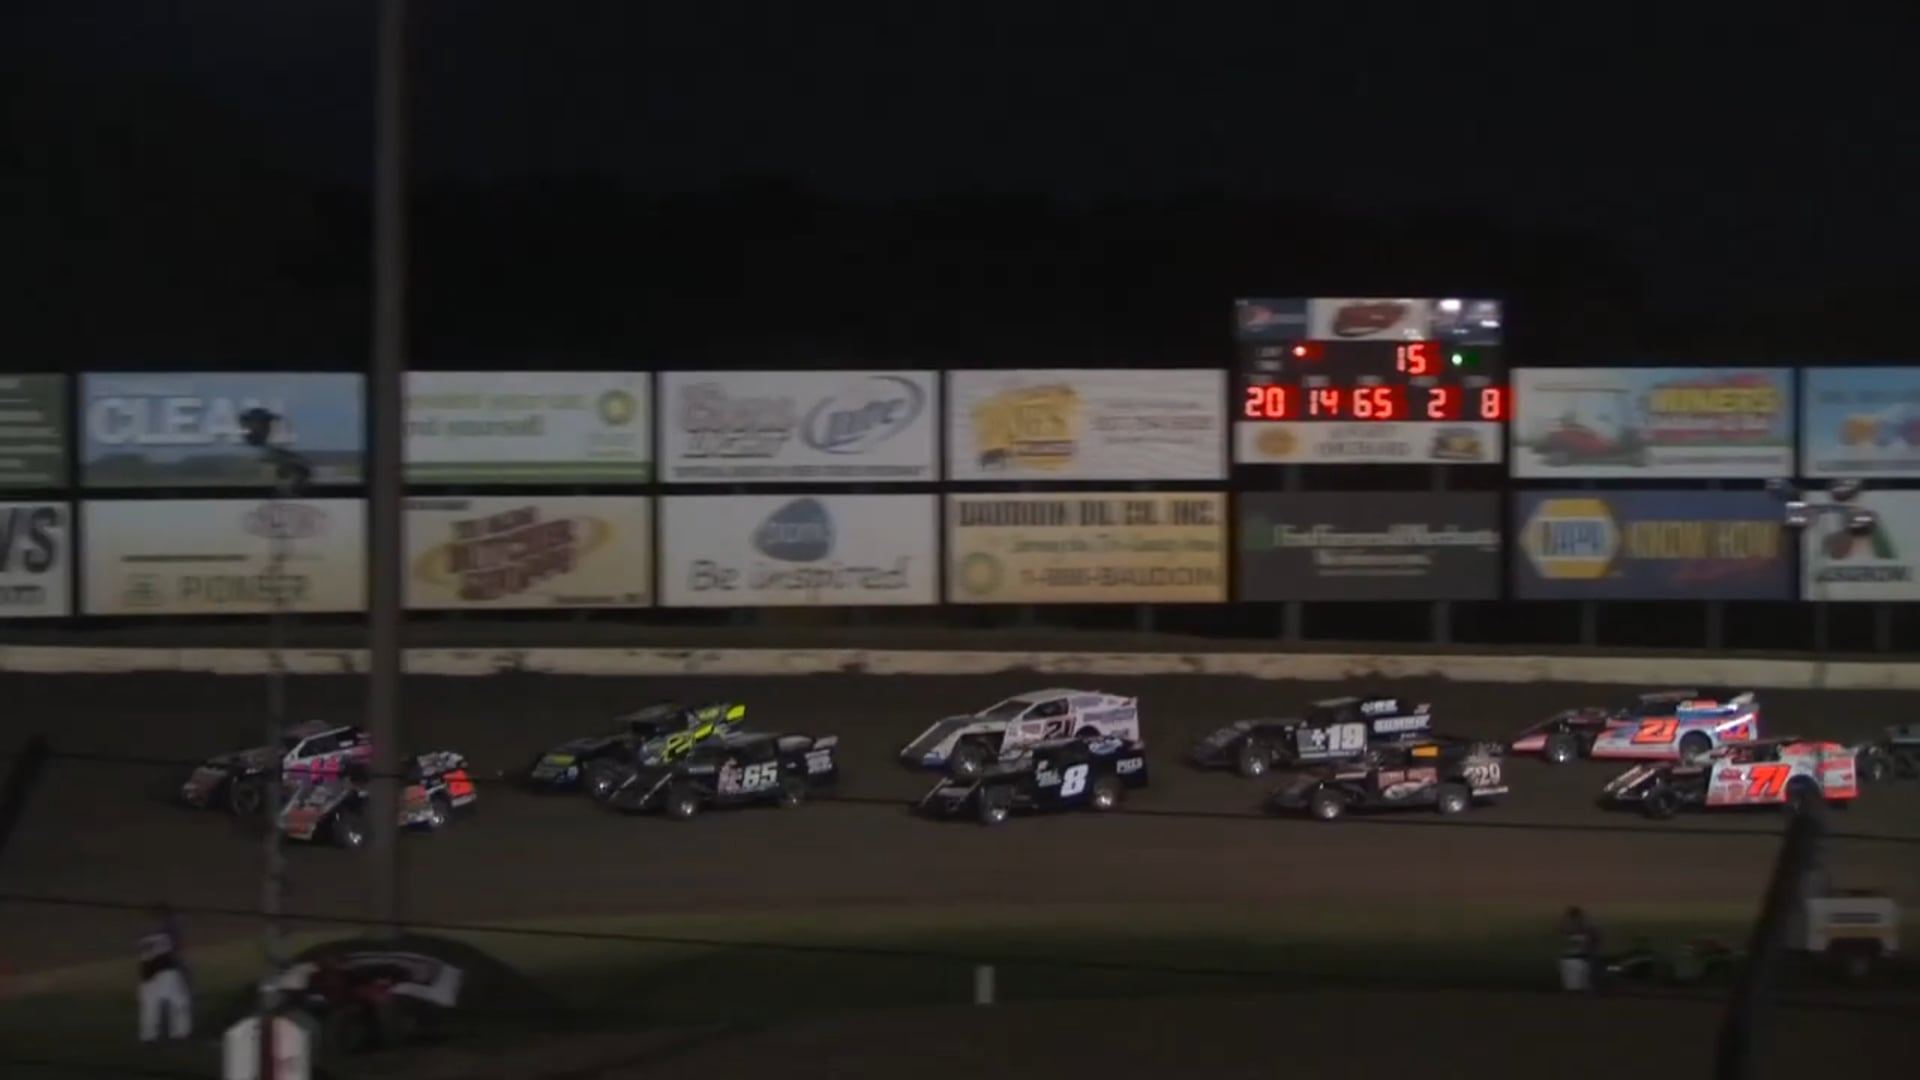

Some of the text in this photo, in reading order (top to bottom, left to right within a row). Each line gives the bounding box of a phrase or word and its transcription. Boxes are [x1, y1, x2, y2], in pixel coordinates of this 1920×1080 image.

[1396, 344, 1426, 374] 15
[1245, 387, 1500, 418] 20 14 65 2 8
[689, 559, 739, 591] Be
[1634, 717, 1679, 743] 21
[742, 761, 778, 789] 65
[1060, 764, 1089, 797] 8
[1748, 765, 1790, 796] 71
